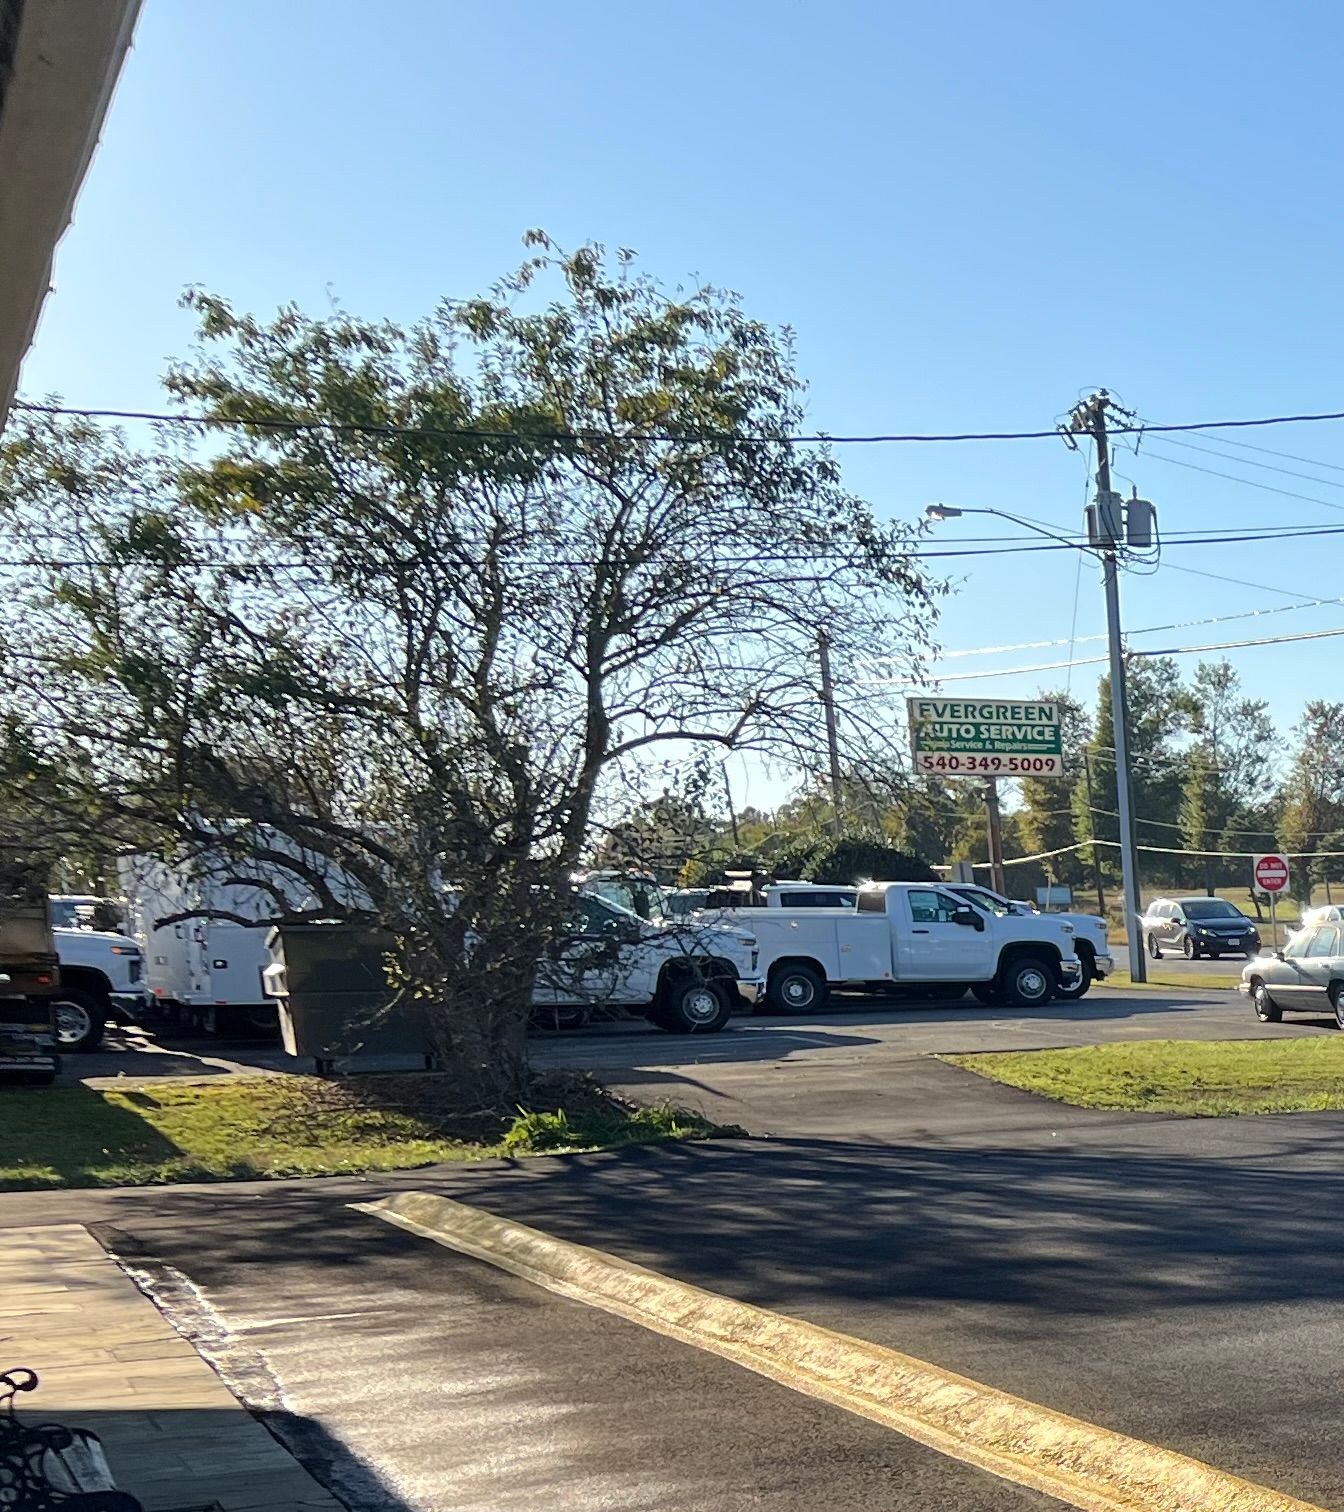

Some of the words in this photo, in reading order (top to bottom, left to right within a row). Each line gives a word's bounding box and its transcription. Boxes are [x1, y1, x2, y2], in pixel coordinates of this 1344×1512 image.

[919, 702, 1053, 722] EVERGREEN
[919, 723, 976, 739] AUTO
[980, 725, 1055, 741] SERVICE
[950, 740, 983, 749] Service
[985, 741, 992, 749] &
[923, 755, 1055, 772] 540-349-5009
